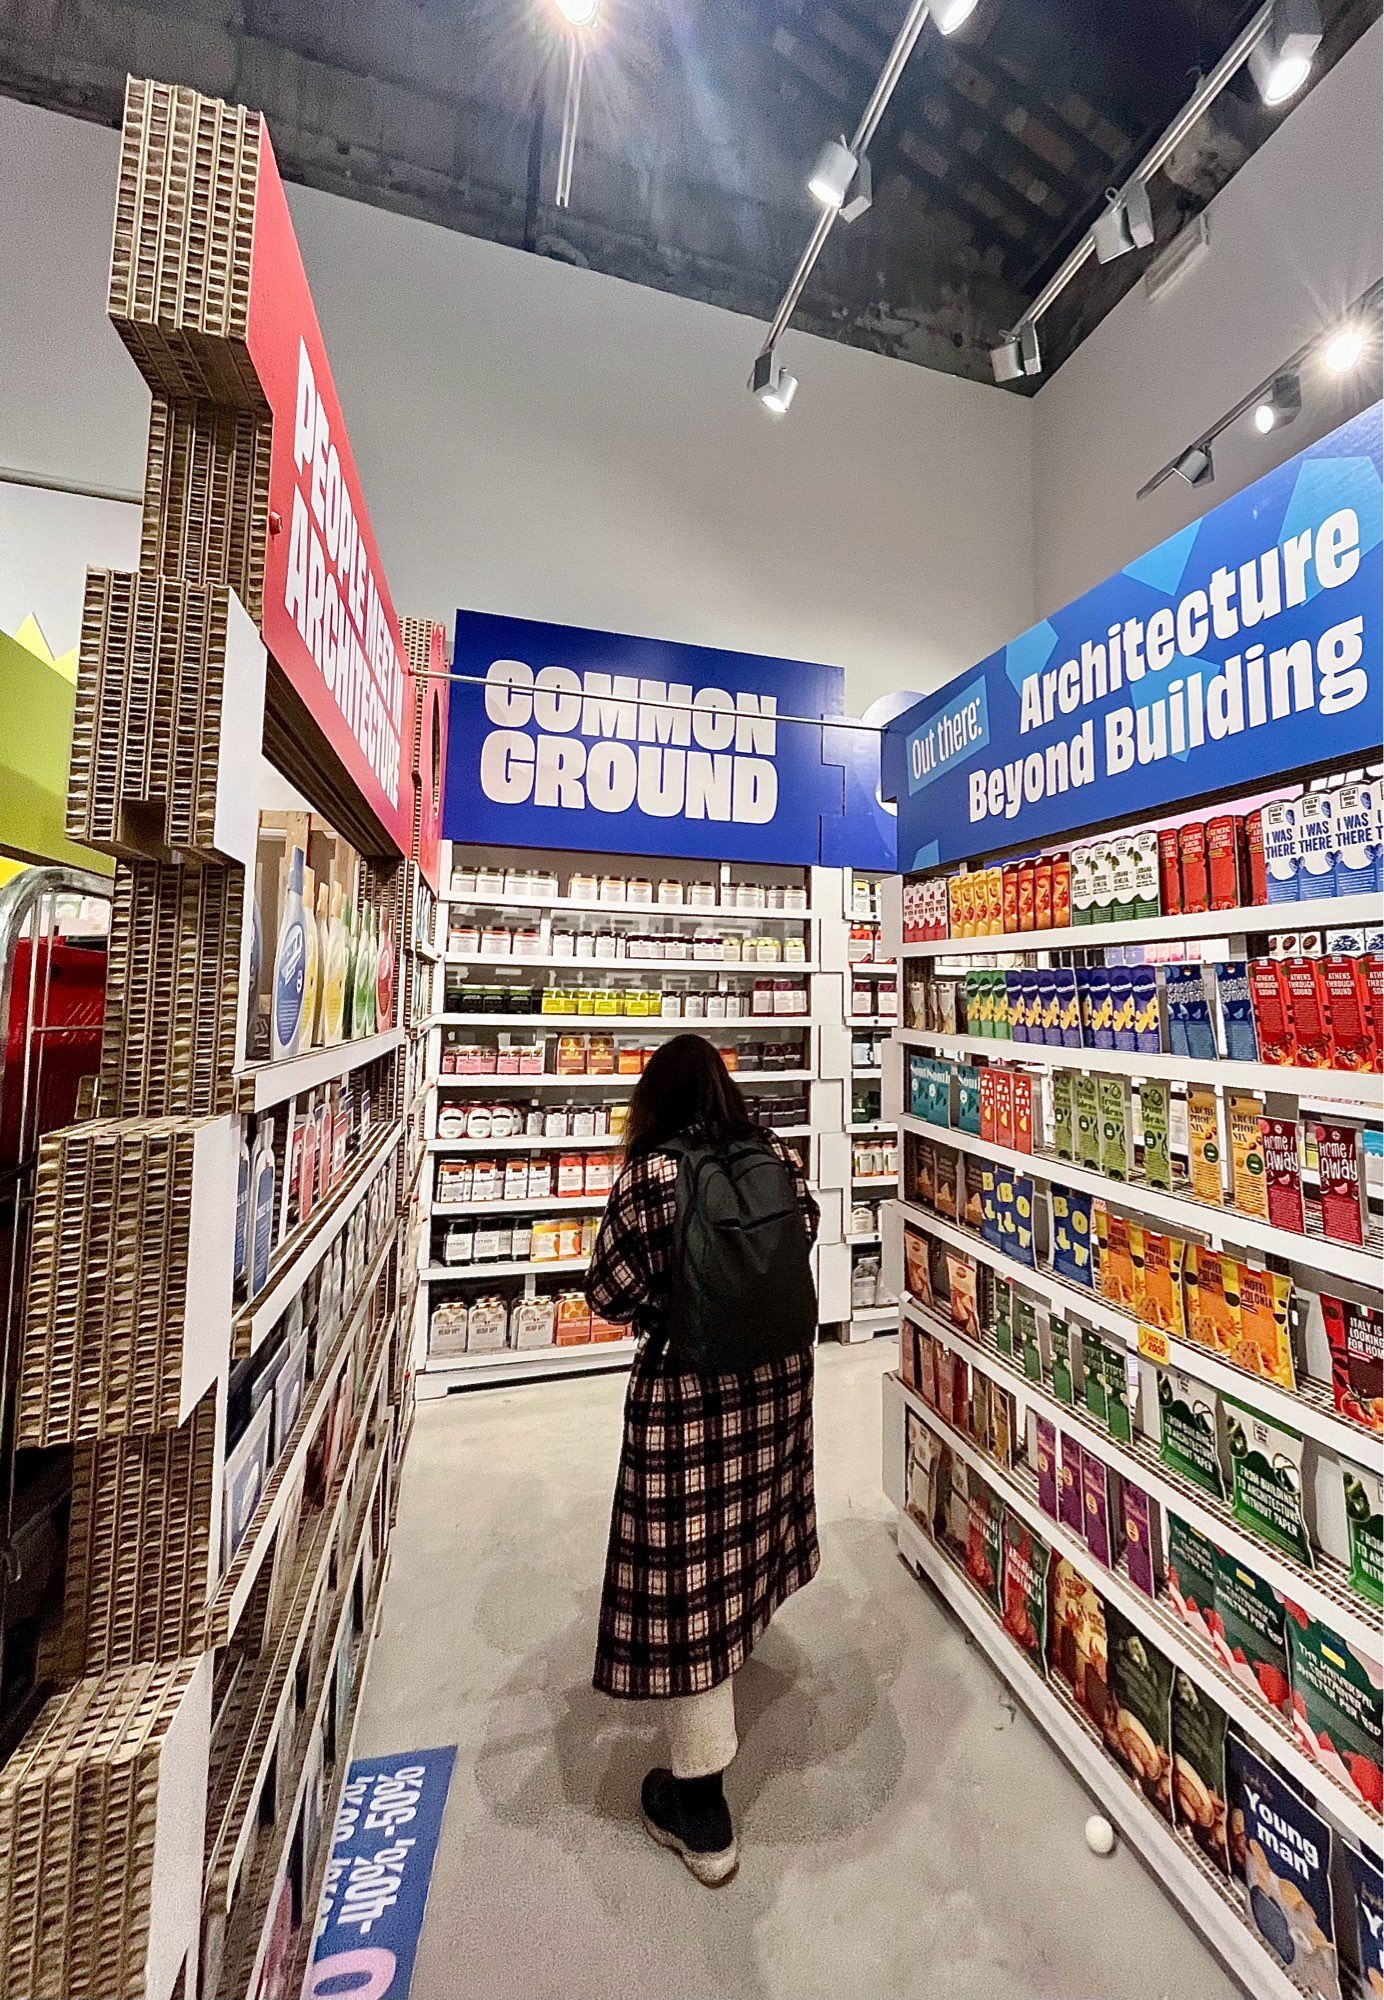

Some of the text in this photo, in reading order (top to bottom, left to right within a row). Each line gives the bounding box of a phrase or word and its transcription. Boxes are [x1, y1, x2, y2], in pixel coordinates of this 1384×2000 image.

[294, 334, 367, 640] PEOPLE
[365, 568, 394, 714] MEET
[1020, 508, 1360, 734] Architecture
[285, 483, 398, 812] ARCHITECTURE
[485, 660, 777, 756] COMMON
[969, 615, 1368, 822] Beyond Building
[912, 697, 982, 780] Out there:
[481, 731, 778, 824] GROUND
[1300, 820, 1329, 838] I WAS
[1337, 812, 1369, 831] I WAS
[1266, 828, 1293, 845] I WAS
[1298, 835, 1332, 854] THERE
[1335, 826, 1372, 847] THERE
[1265, 842, 1296, 859] THERE
[1293, 988, 1312, 996] SOUND
[1326, 980, 1354, 988] THROUGH
[1331, 988, 1352, 996] SOUND
[1147, 1243, 1165, 1256] HOTEL
[1145, 1252, 1169, 1268] POLONIA
[1201, 1259, 1222, 1272] HOTEL
[1244, 1277, 1267, 1295] HOTEL
[1241, 1289, 1272, 1308] POLONIA
[1350, 1317, 1382, 1336] ITALY IS
[1348, 1337, 1363, 1351] FOR
[1194, 1452, 1213, 1472] PAPER
[1237, 1476, 1246, 1490] TO
[1240, 1465, 1259, 1486] FROM
[1241, 1491, 1297, 1536] WITHOUT PAPER
[1298, 1642, 1375, 1711] THE UNIVERSAL
[364, 1766, 426, 1836] -50%
[1243, 1784, 1319, 1869] Young
[1257, 1822, 1309, 1880] man
